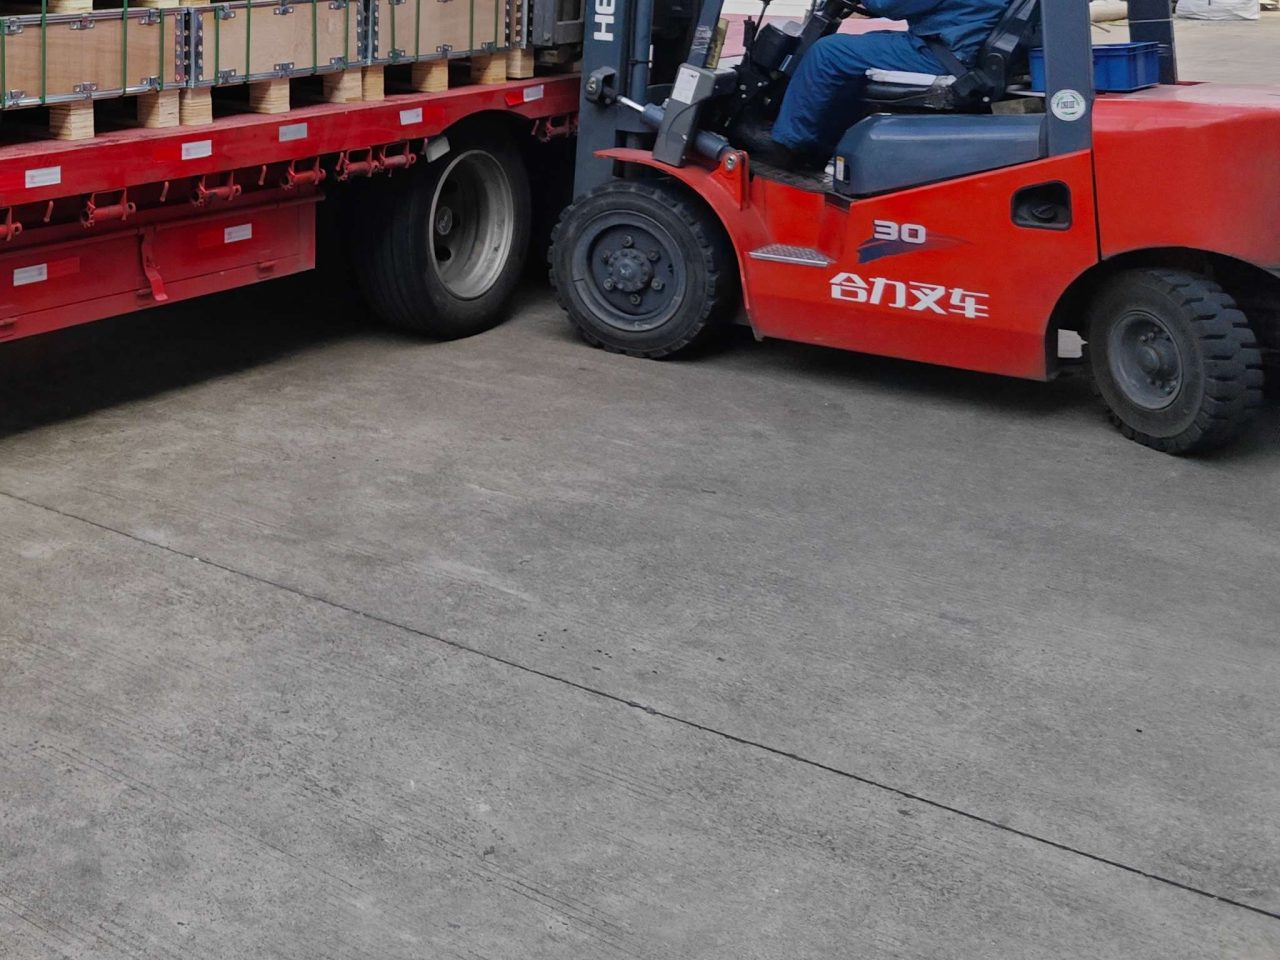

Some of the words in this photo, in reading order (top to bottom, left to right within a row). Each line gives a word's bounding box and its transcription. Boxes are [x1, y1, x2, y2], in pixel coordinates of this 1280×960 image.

[873, 219, 926, 244] 30
[829, 271, 990, 319] 合力叉车
